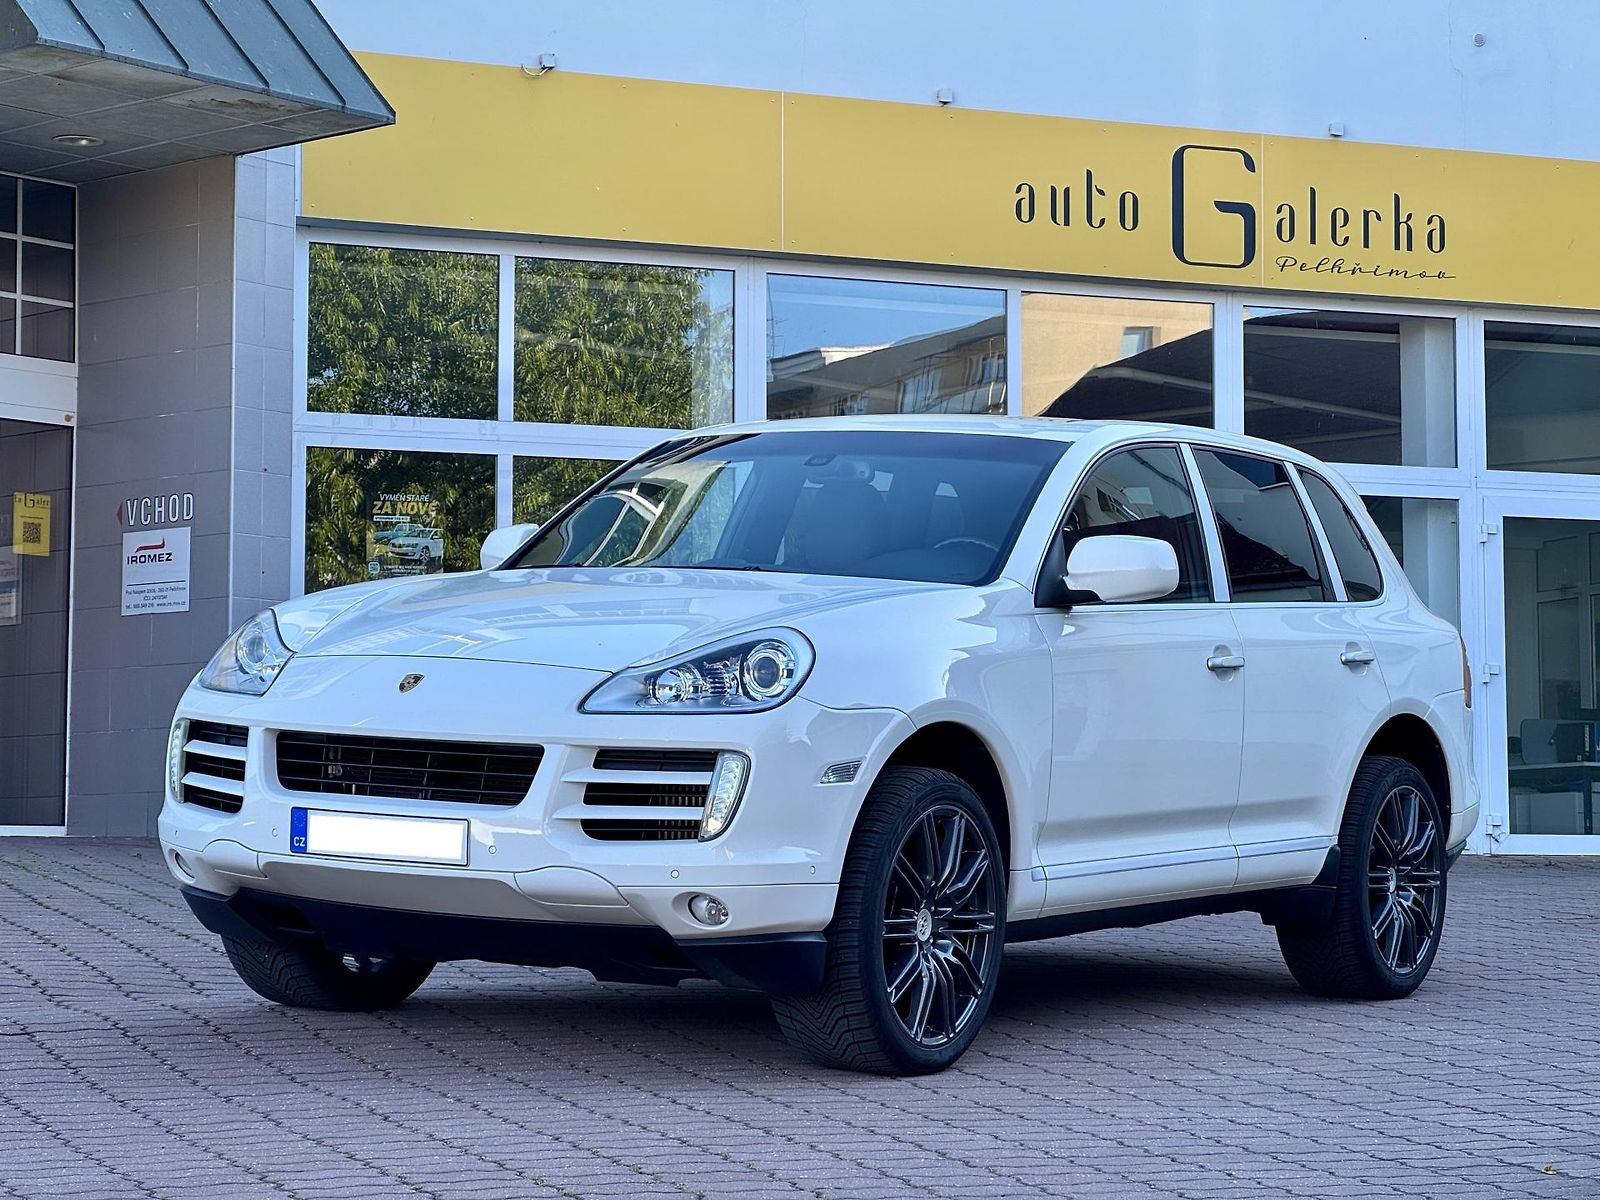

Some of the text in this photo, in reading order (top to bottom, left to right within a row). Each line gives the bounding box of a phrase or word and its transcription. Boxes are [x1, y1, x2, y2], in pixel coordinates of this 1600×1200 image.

[1015, 168, 1139, 231] auto
[1275, 255, 1457, 280] Pelhřimov
[126, 493, 194, 526] VCHOD
[372, 501, 392, 514] ZA
[127, 552, 173, 565] IROMEZ
[293, 836, 306, 847] CZ
